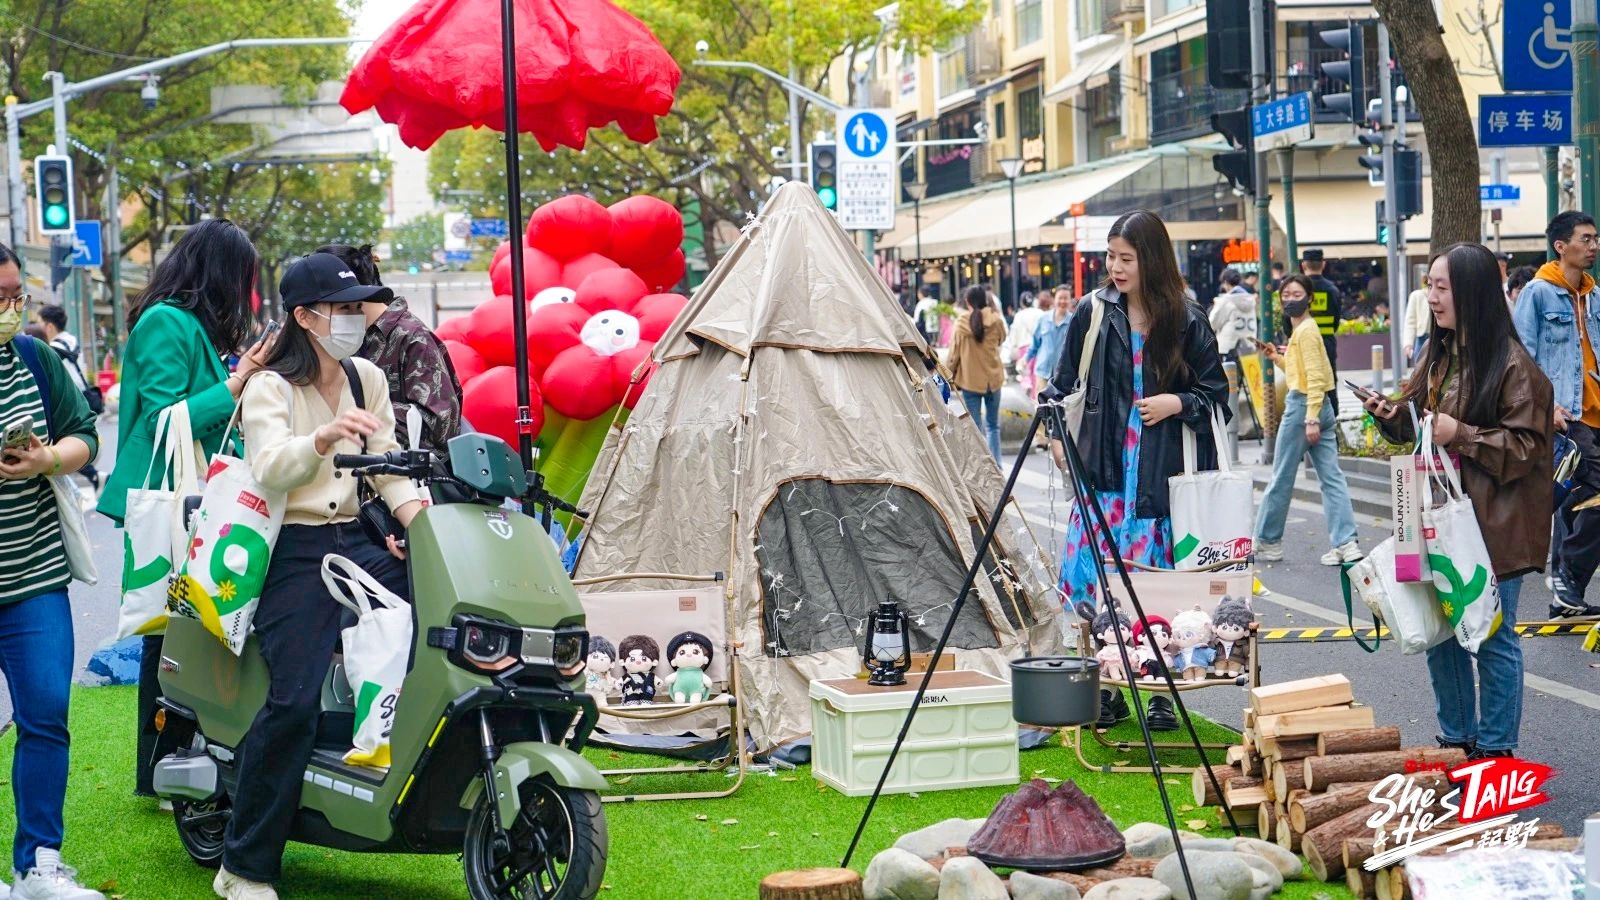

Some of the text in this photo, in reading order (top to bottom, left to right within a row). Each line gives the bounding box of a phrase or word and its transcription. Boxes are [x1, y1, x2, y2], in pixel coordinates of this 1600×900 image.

[1265, 103, 1295, 129] 大学路
[1487, 109, 1563, 133] 停车场
[1396, 468, 1405, 542] BOJUNYIXIAO
